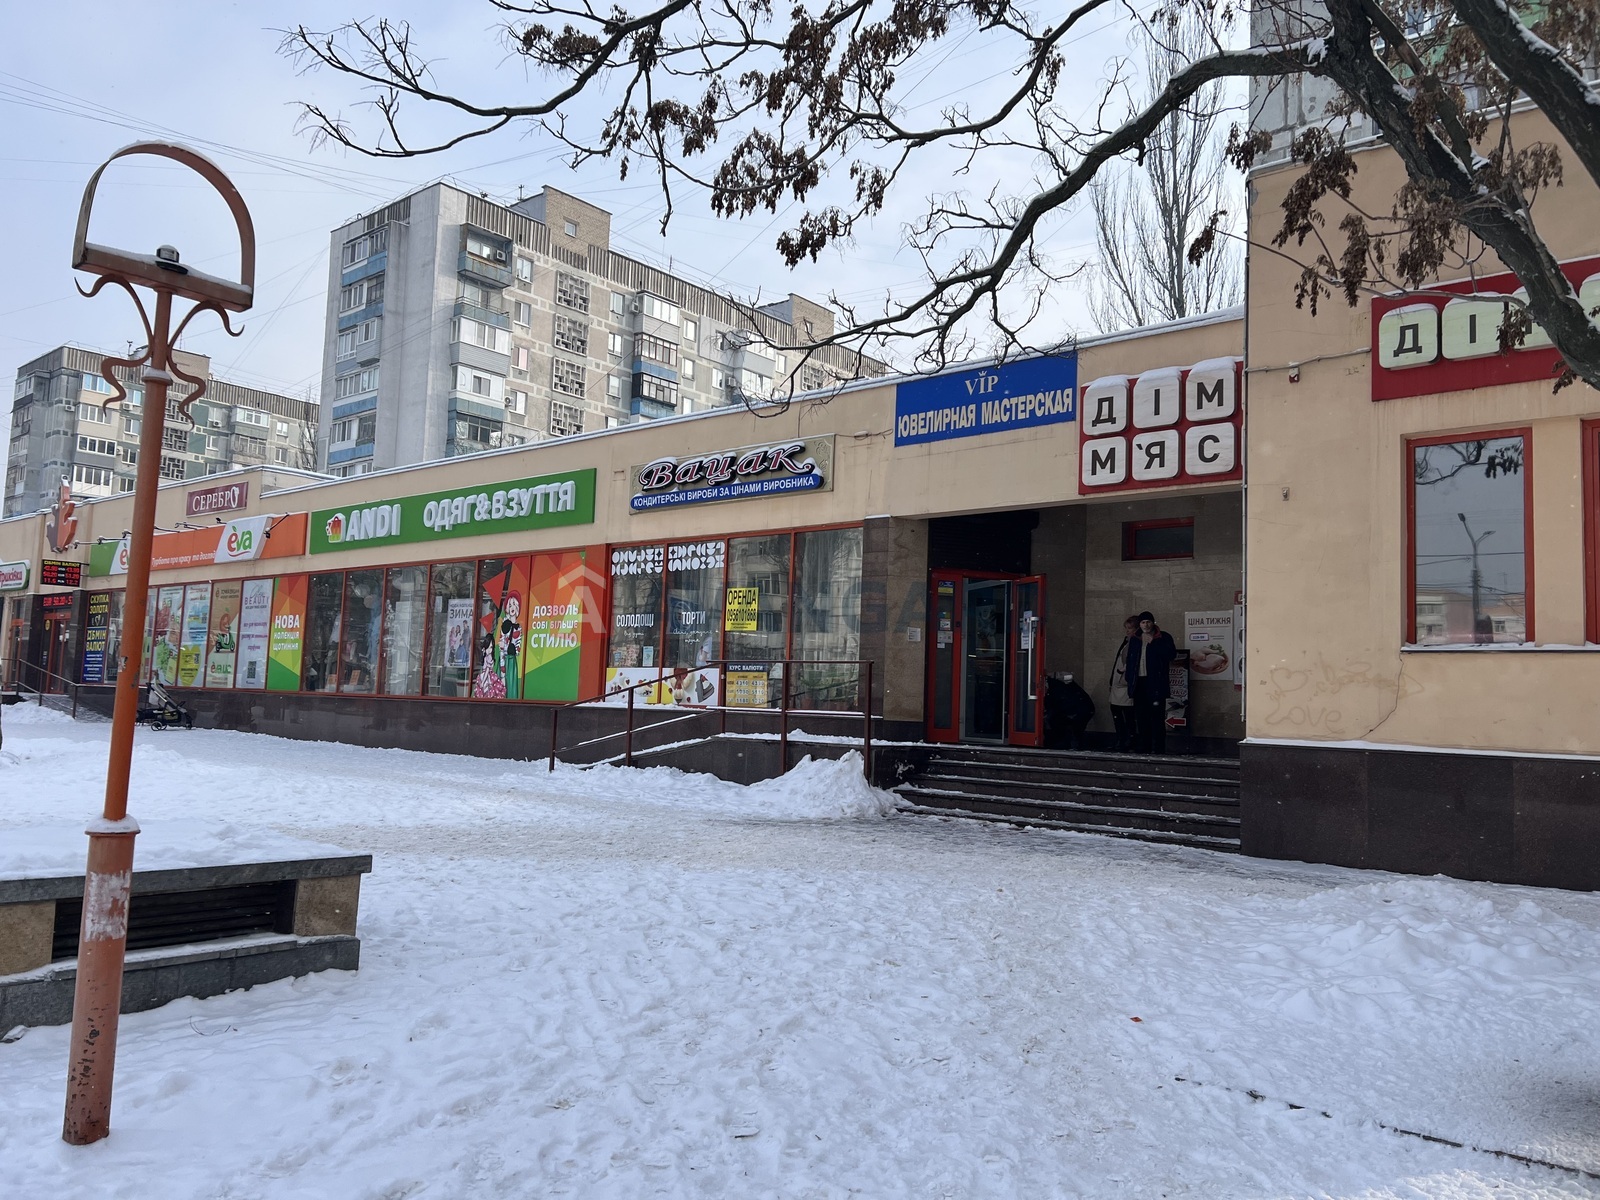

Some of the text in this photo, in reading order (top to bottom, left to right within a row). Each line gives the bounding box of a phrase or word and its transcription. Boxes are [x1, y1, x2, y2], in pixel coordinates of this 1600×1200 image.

[1393, 313, 1532, 358] ДІ
[965, 374, 999, 396] VIP
[1091, 378, 1225, 428] ДІМ
[898, 388, 1073, 438] ЮВЕЛИРНАЯ МАСТЕРСКАЯ
[639, 443, 815, 491] Вацак
[192, 486, 240, 512] СЕРЕБРО
[633, 476, 815, 507] КОНДИТЕРСЬКІ ВИРОБИ ЗА ЦІНАМИ ВИРОБНИКА
[423, 480, 576, 532] ОДЯГ&ВЗУТТЯ
[345, 503, 401, 541] ANDI
[90, 594, 109, 604] СКУПКА
[728, 589, 757, 606] ОРЕНДА
[89, 604, 108, 614] ЗОЛОТА
[449, 608, 473, 619] ЗИМА
[532, 604, 579, 619] ДОЗВОЛЬ
[274, 614, 300, 629] НОВА
[532, 619, 578, 630] СОБІ БІЛЬШЕ
[616, 613, 654, 628] СОЛОДОЩІ
[682, 611, 706, 625] ТОРТИ
[1188, 617, 1231, 626] ЦІНА ТИЖНЯ
[273, 631, 299, 640] КОЛЕКЦІЯ
[531, 632, 578, 649] СТИЛЮ
[272, 642, 299, 651] ЩОТИЖНЯ
